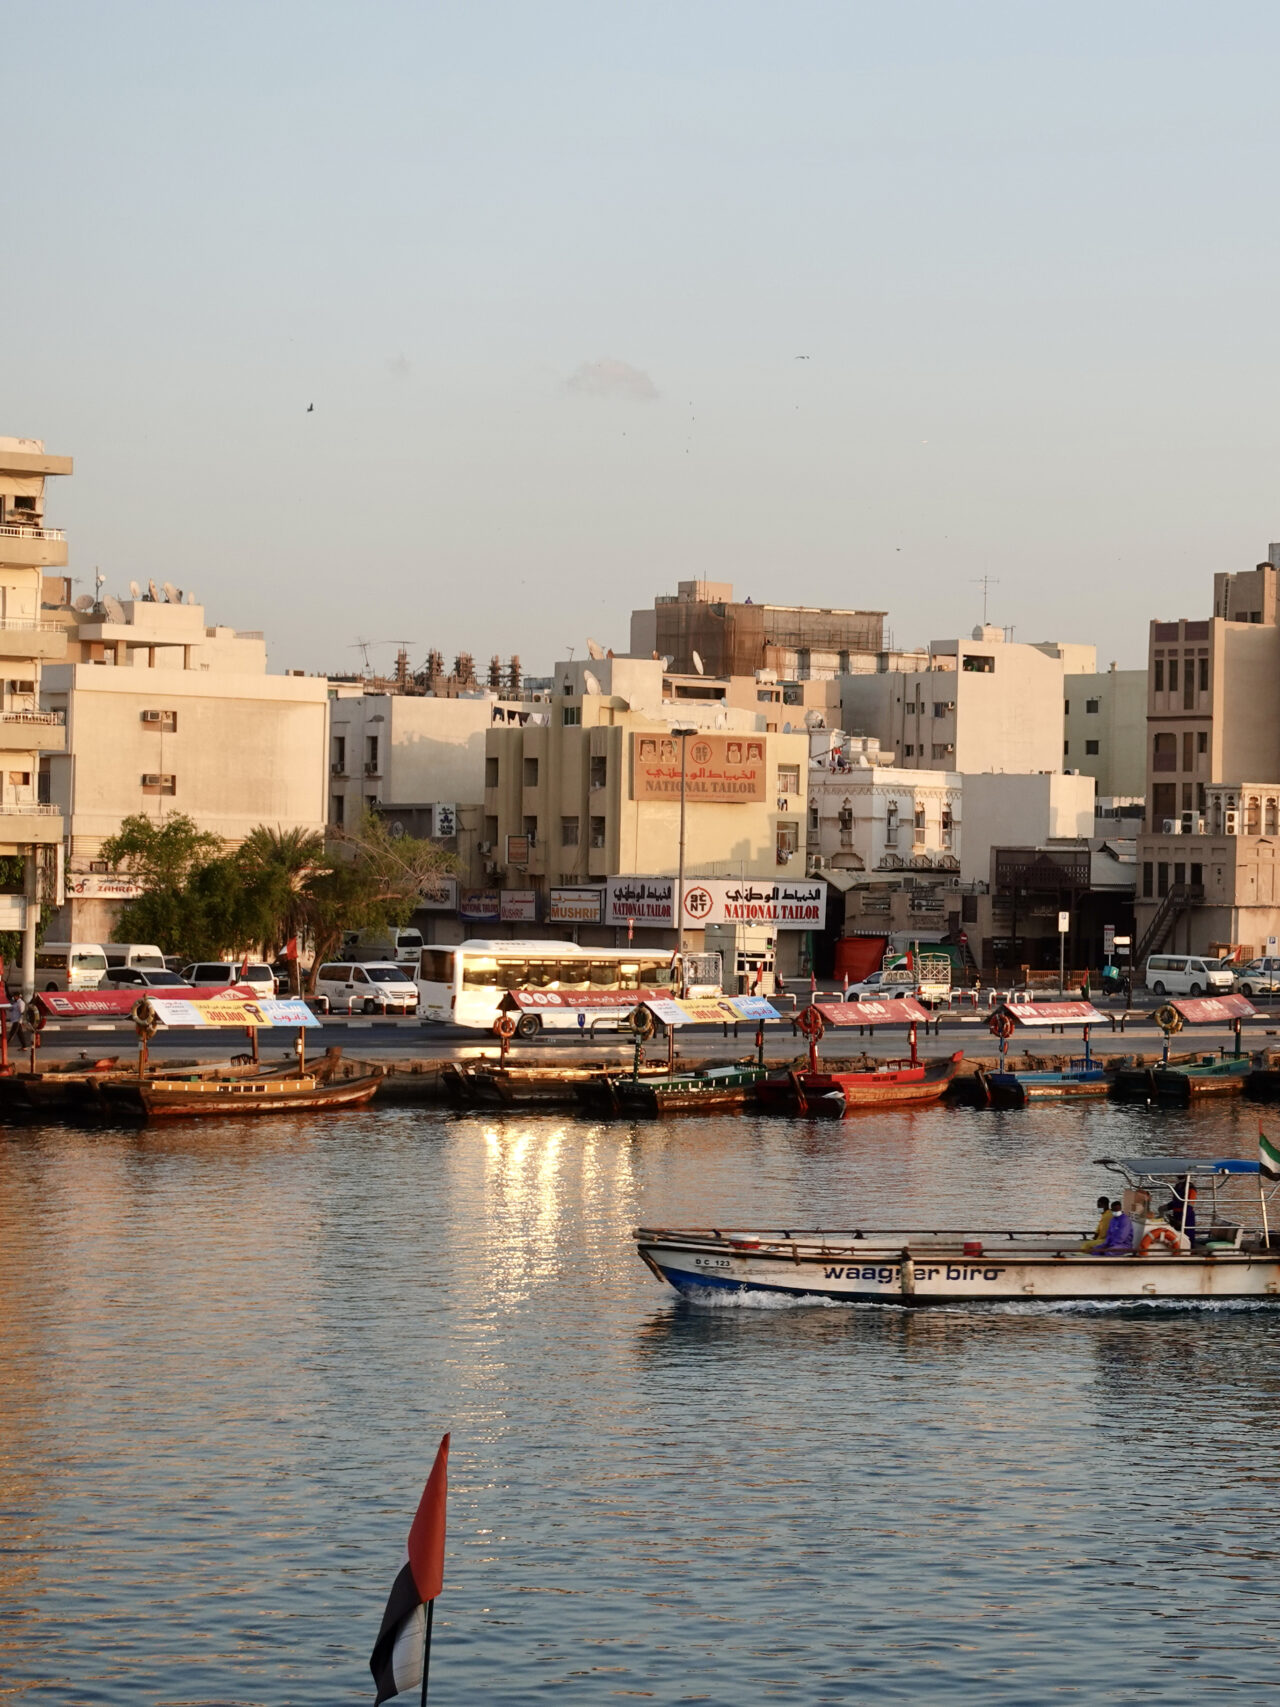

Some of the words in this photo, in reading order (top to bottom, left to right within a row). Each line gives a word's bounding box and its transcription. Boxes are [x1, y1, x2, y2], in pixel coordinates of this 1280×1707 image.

[706, 769, 756, 781] الخياط
[646, 780, 708, 793] NATIONAL
[711, 782, 756, 794] TAILOR
[613, 884, 645, 903] الوطني
[646, 885, 672, 900] الخياط
[725, 886, 779, 903] الوطني
[781, 887, 821, 901] الخياط
[551, 907, 600, 919] MUSHRIF
[612, 902, 644, 916] NATIONAL
[644, 904, 671, 918] TAILOR
[690, 902, 707, 912] NT
[724, 903, 781, 919] NATIONAL
[781, 905, 820, 920] TAILOR
[823, 1265, 940, 1284] waager
